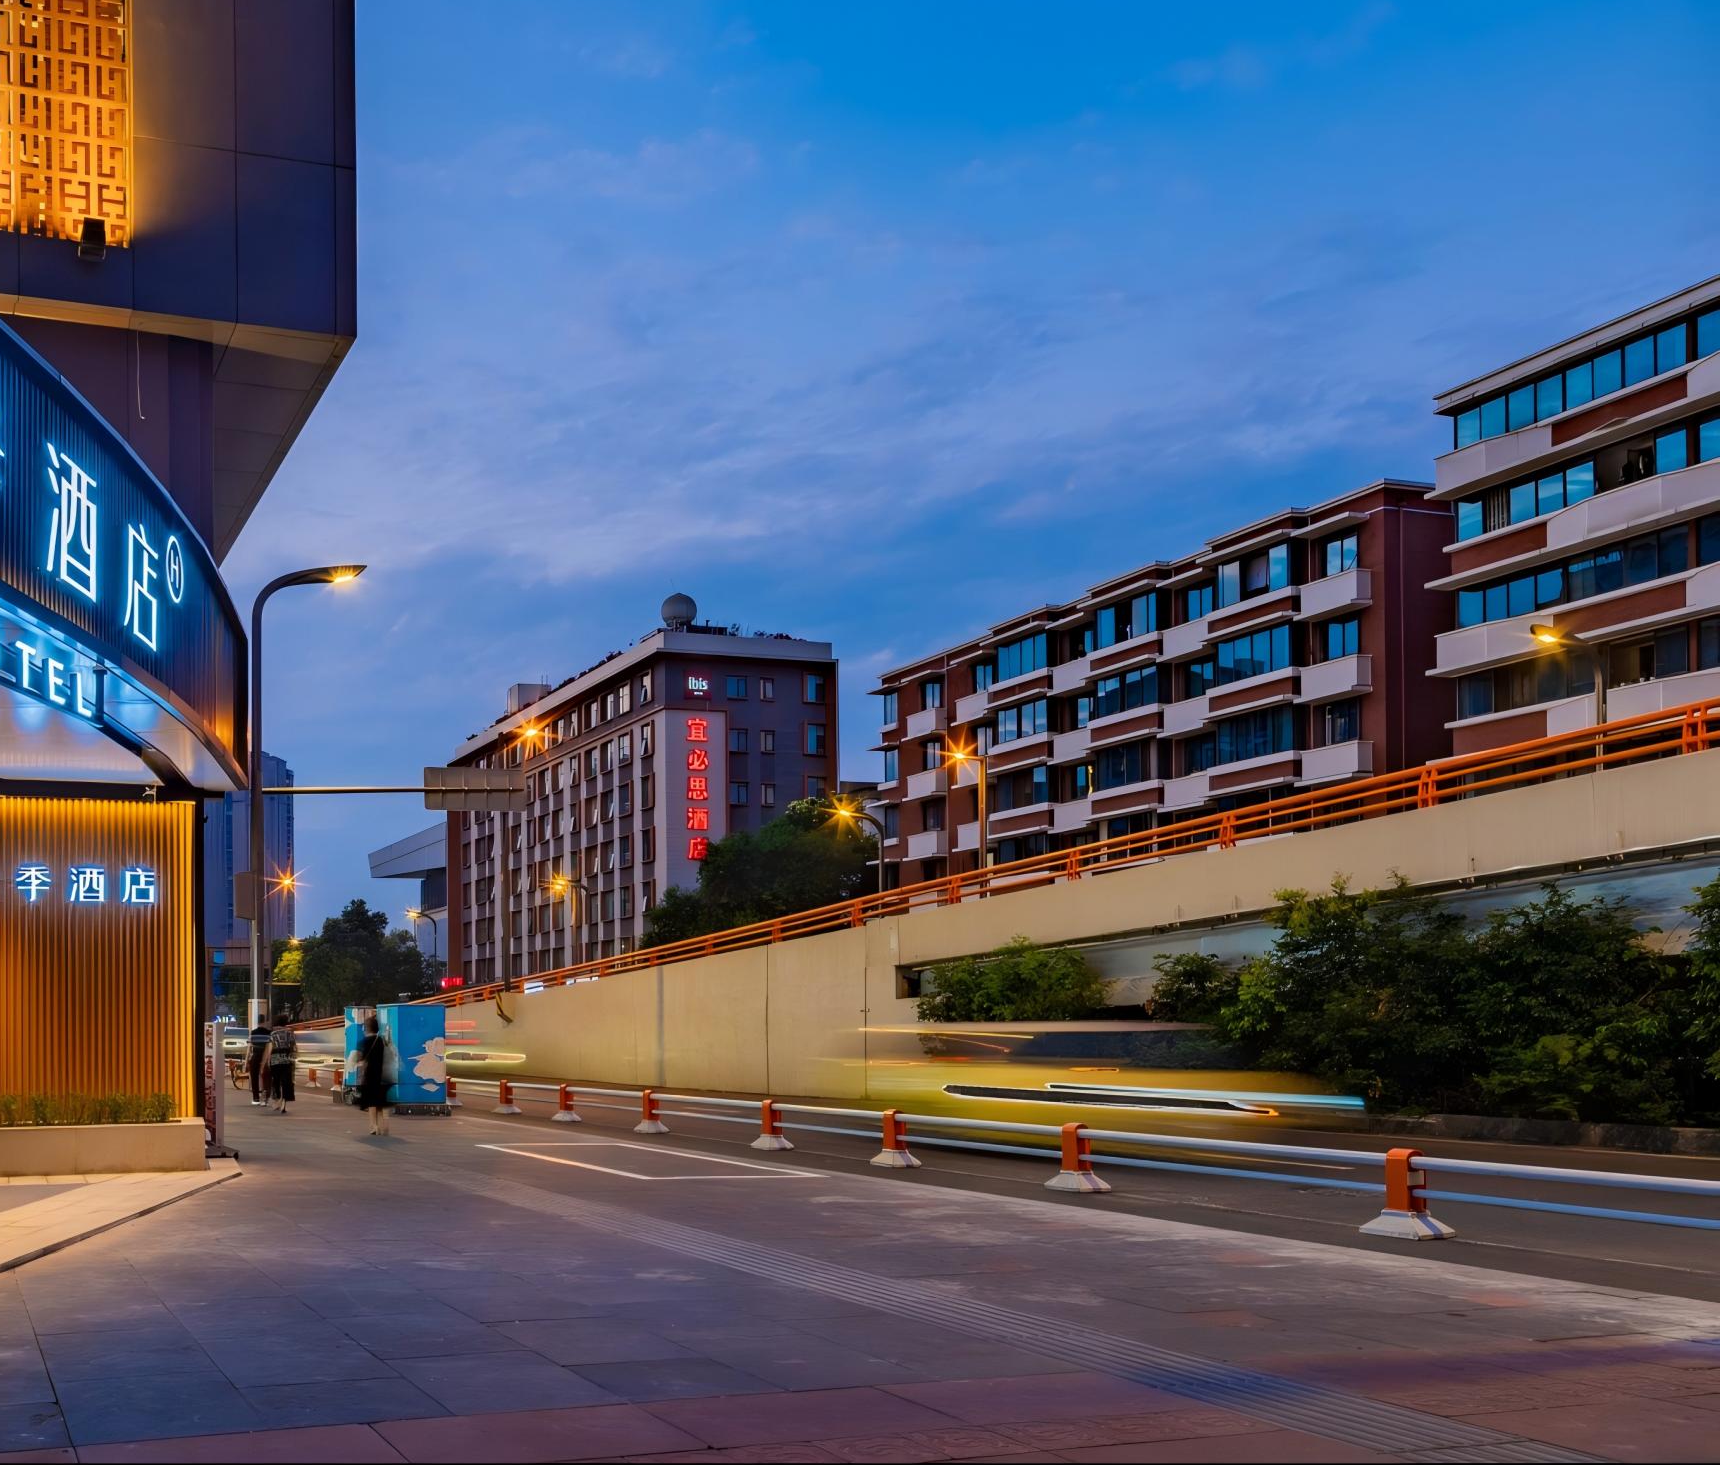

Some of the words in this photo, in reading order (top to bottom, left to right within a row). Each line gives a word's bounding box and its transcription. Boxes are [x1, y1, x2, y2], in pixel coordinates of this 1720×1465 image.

[688, 676, 709, 690] ibis
[685, 717, 710, 861] 宜必思酒店
